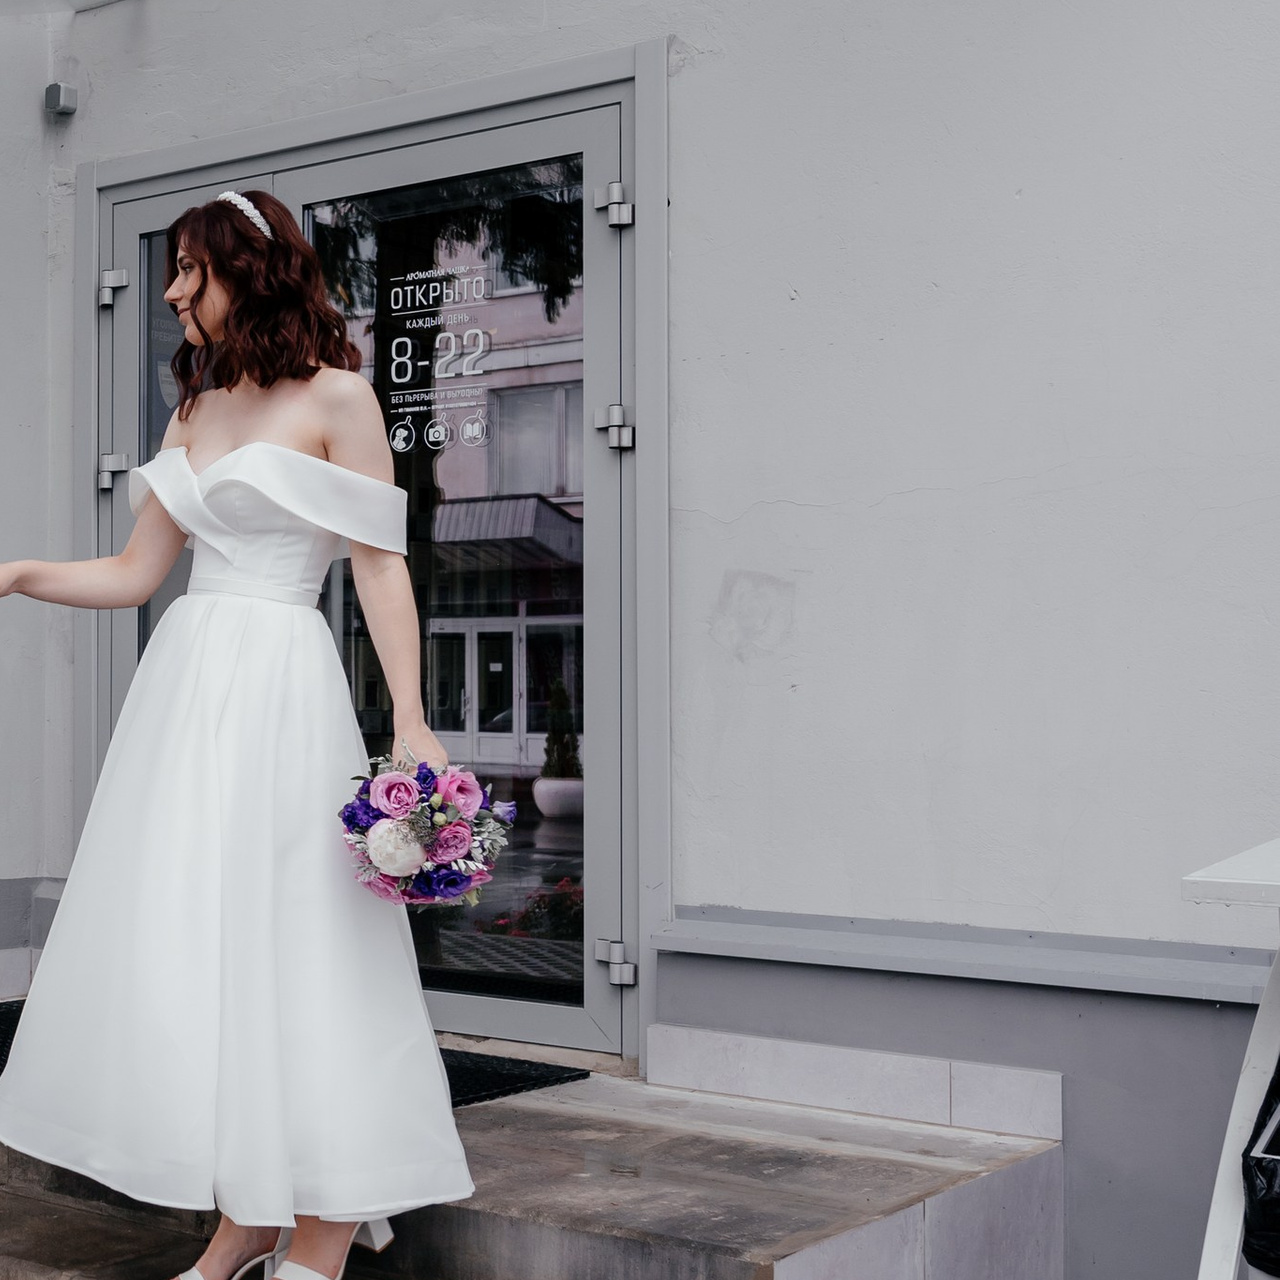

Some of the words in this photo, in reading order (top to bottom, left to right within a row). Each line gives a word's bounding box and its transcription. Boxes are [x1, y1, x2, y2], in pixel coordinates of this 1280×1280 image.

[390, 276, 485, 310] ОТКРЫТО
[405, 315, 444, 329] КАЖДЫЙ
[447, 313, 470, 325] ДЕНЬ
[390, 328, 484, 384] 8-22
[391, 395, 404, 404] БЕЗ
[404, 391, 438, 403] ПЕРЕРЫВА
[440, 391, 446, 400] И
